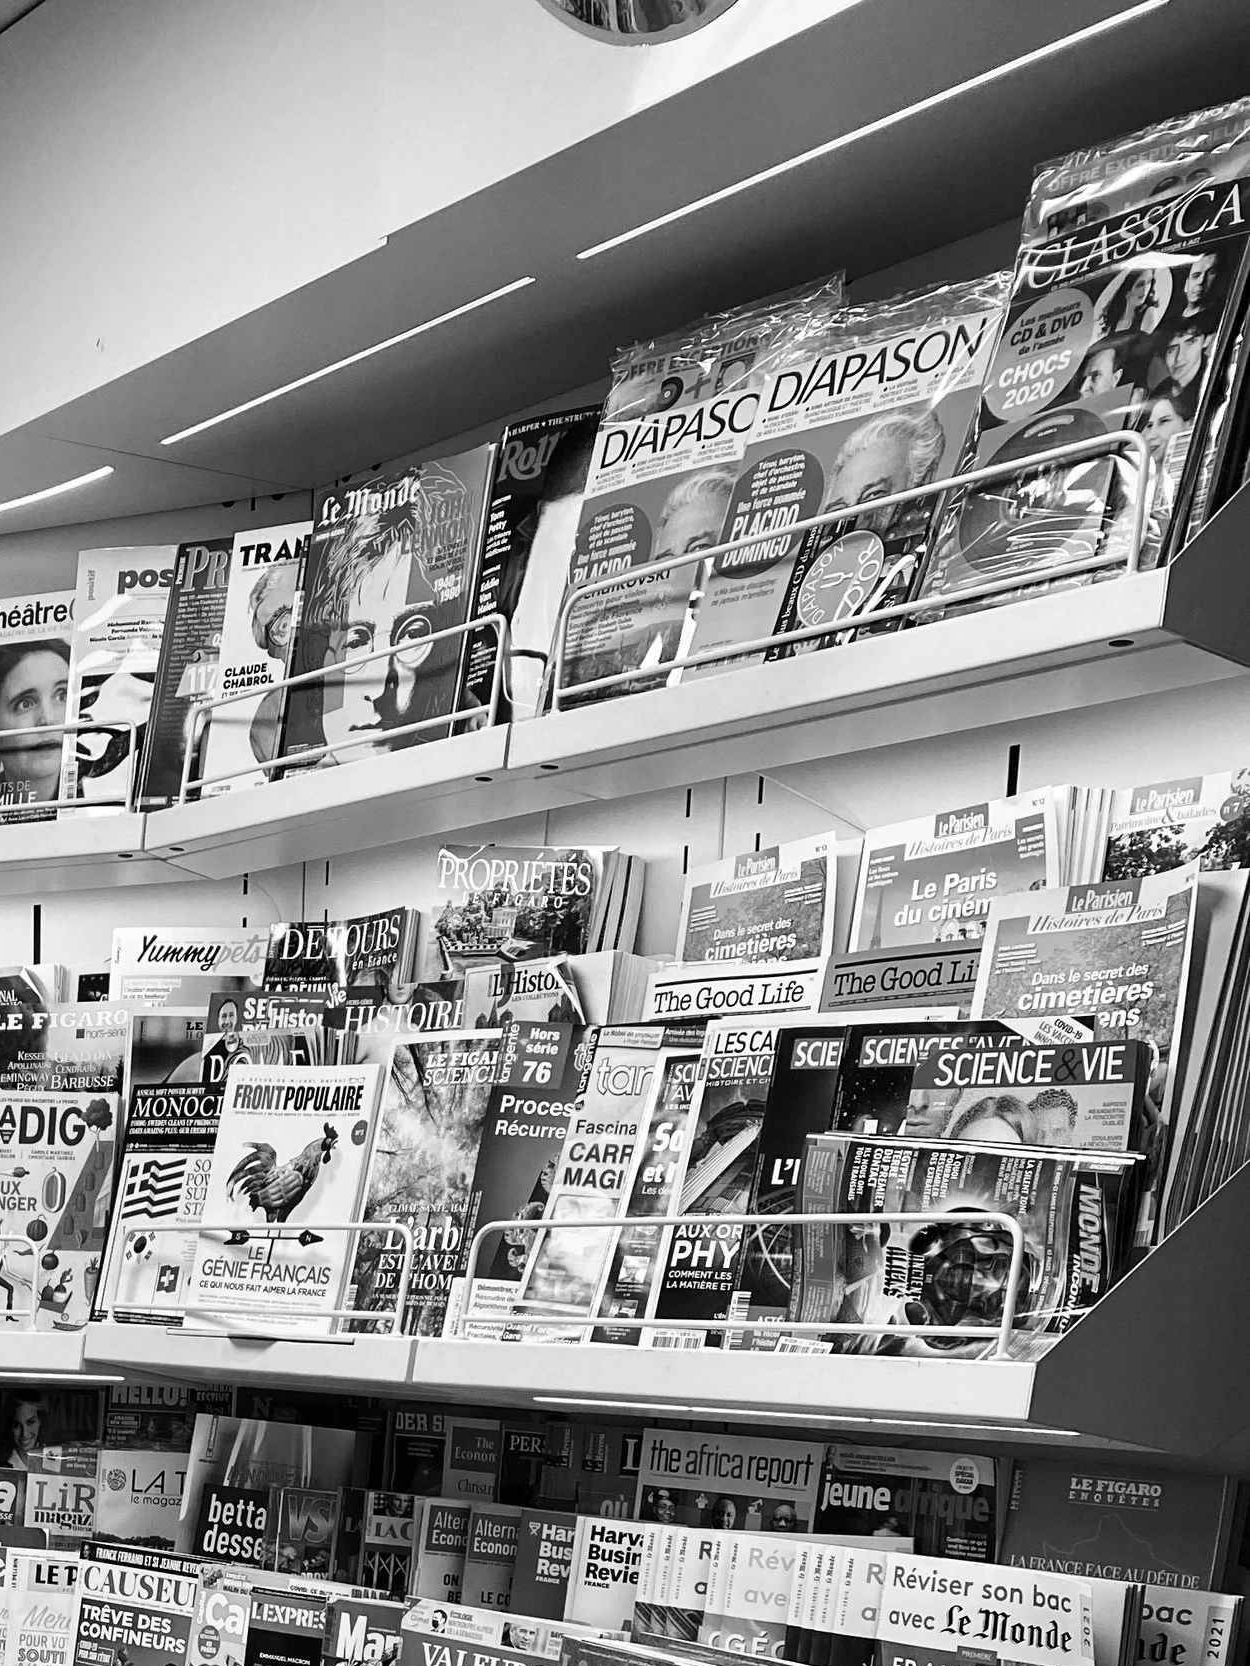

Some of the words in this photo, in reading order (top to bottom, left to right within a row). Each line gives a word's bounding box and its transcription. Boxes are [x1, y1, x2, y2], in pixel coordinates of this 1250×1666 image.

[1027, 181, 1247, 291] CLASSICA
[1010, 326, 1034, 347] CD
[1035, 324, 1048, 340] &
[1050, 310, 1084, 336] DVD
[768, 317, 988, 414] DIAPASON
[998, 350, 1073, 388] CHOCS
[1002, 378, 1055, 411] 2020
[318, 498, 343, 527] Le
[348, 476, 422, 520] Monde
[730, 503, 800, 540] PLACIDO
[223, 674, 274, 689] CHABROL
[224, 662, 267, 677] CLAUDE
[438, 855, 592, 897] PROPRIÉTÉS
[1072, 895, 1083, 911] Le
[1085, 890, 1133, 909] Parisien
[1032, 914, 1102, 932] Histoires
[1105, 908, 1124, 924] de
[1126, 903, 1164, 921] Paris
[281, 915, 401, 962] DÉTOURS
[1032, 971, 1065, 986] Dans
[1068, 971, 1080, 983] le
[1083, 967, 1122, 982] secret
[1125, 963, 1149, 977] des
[653, 990, 692, 1013] The
[696, 985, 756, 1010] Good
[761, 980, 805, 1005] Life
[1017, 980, 1154, 1011] cimetières
[32, 1009, 128, 1029] FIGARO
[530, 1027, 560, 1042] Hors
[526, 1042, 559, 1055] série
[522, 1060, 552, 1084] 76
[934, 1049, 1054, 1086] SCIENCE
[1054, 1048, 1082, 1080] &
[1081, 1045, 1126, 1081] VIE
[249, 1246, 265, 1260] LE
[1078, 1183, 1102, 1293] MONDE
[202, 1256, 249, 1279] GÉNIE
[251, 1263, 330, 1286] FRANÇAIS
[199, 1280, 211, 1288] CE
[212, 1281, 222, 1289] QUI
[224, 1282, 245, 1291] NOUS
[246, 1284, 262, 1293] FAIT
[287, 1287, 296, 1295] LA
[298, 1289, 326, 1297] FRANCE
[651, 1439, 682, 1473] the
[685, 1444, 743, 1479] africa
[748, 1453, 814, 1492] report
[820, 1479, 891, 1512] jeune
[1070, 1476, 1094, 1493] LE
[1098, 1479, 1162, 1498] FIGARO
[892, 1565, 977, 1599] Réviser
[981, 1578, 1024, 1605] son
[1032, 1585, 1073, 1614] bac
[82, 1603, 132, 1628] TRÊVE
[137, 1614, 172, 1633] DES
[888, 1607, 935, 1632] avec
[941, 1604, 971, 1636] Le
[974, 1605, 1073, 1654] Monde
[1081, 1605, 1092, 1647] 2021
[80, 1621, 185, 1654] CONFINEURS
